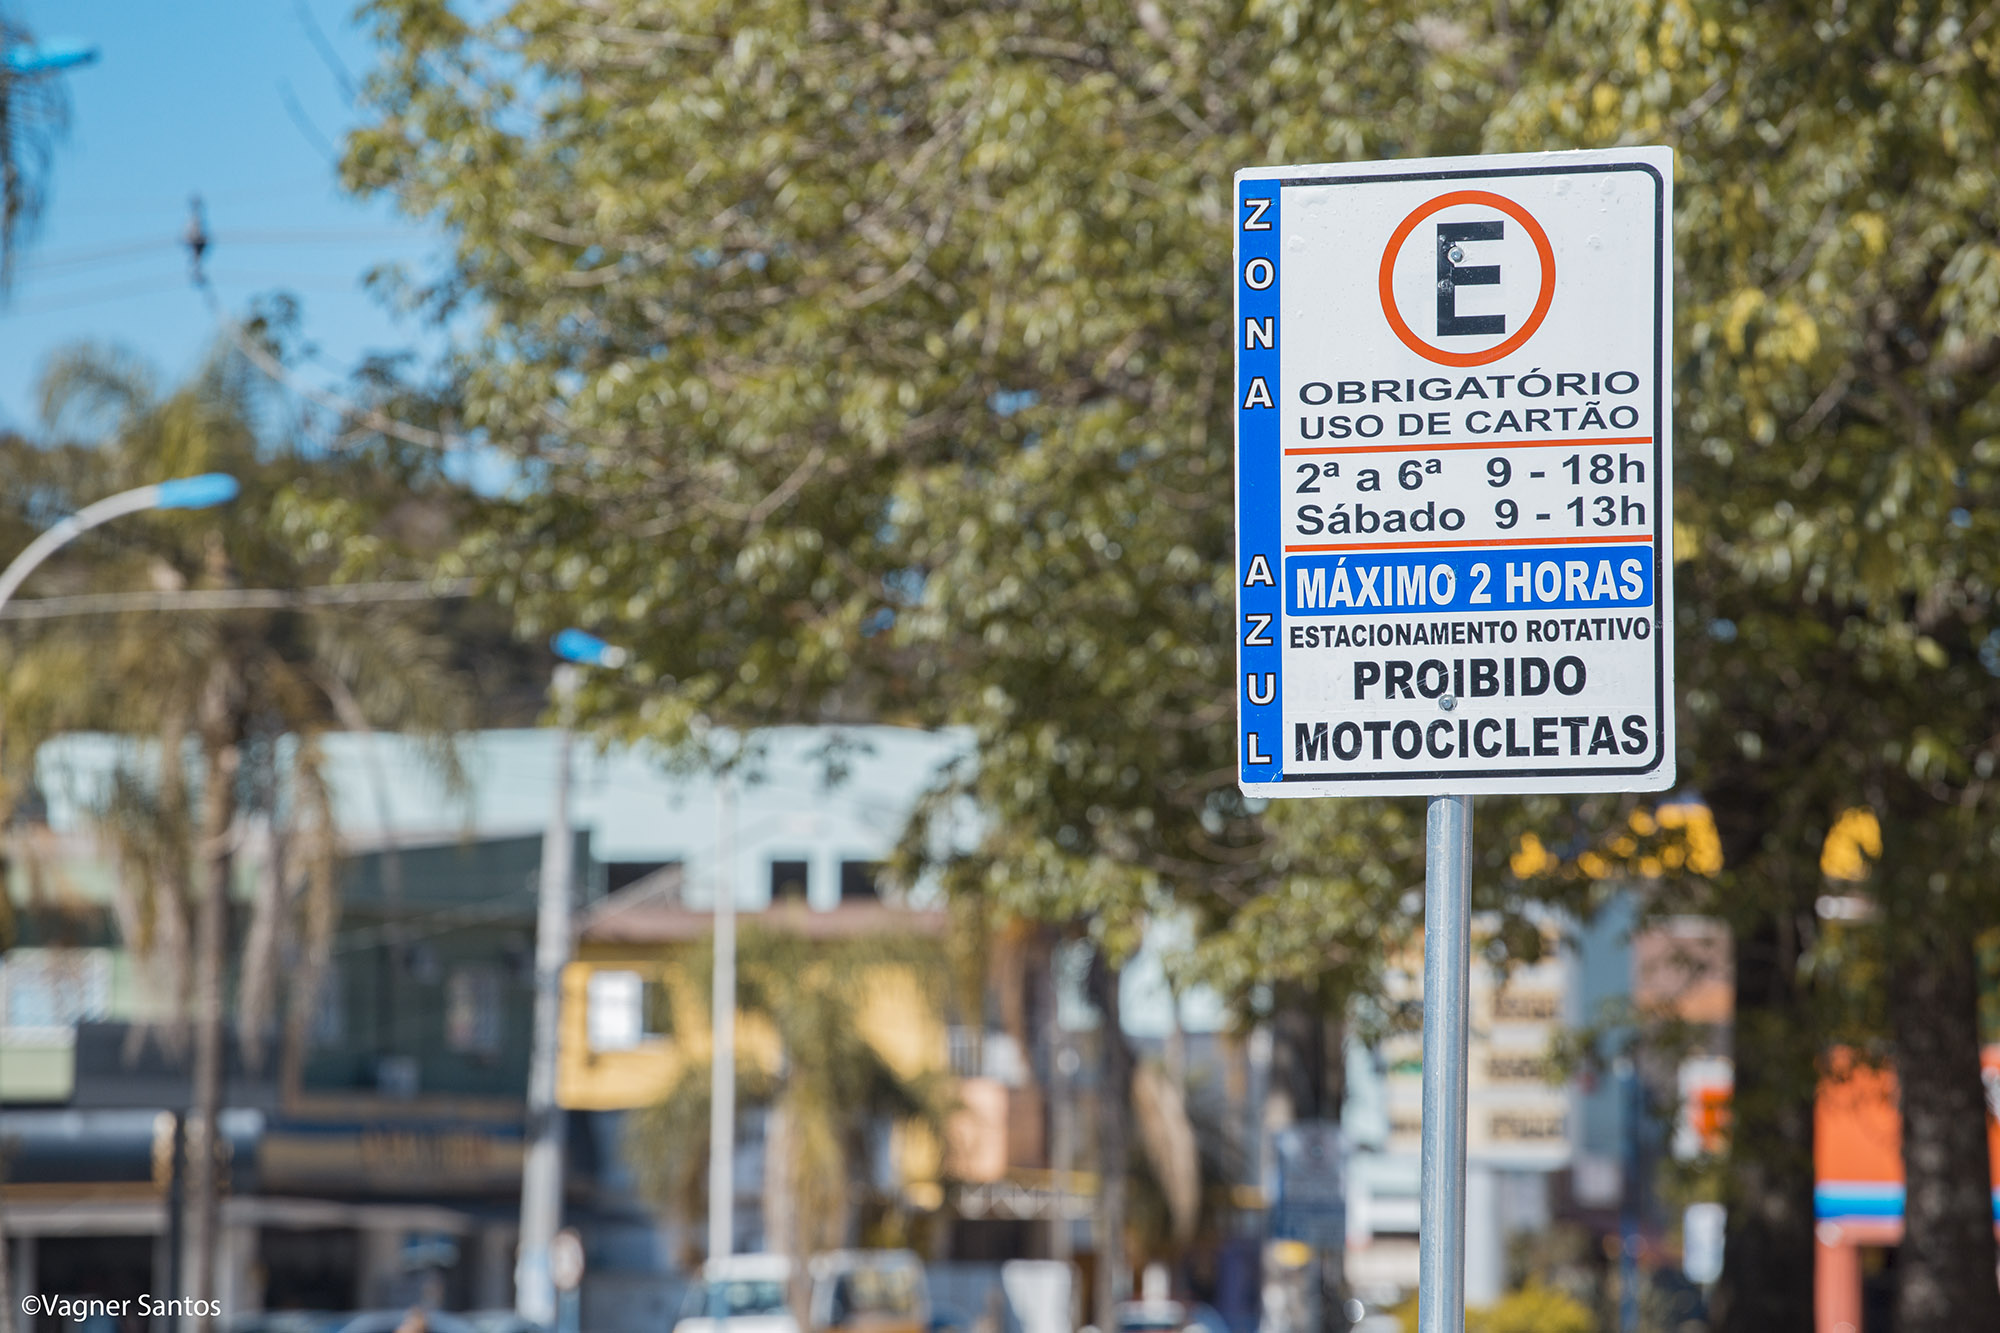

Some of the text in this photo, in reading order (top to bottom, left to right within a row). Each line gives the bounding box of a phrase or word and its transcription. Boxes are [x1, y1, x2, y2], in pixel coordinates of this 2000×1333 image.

[1437, 220, 1506, 336] E
[1243, 198, 1275, 410] ZONA
[1299, 368, 1640, 406] OBRIGATÓRIO
[1300, 401, 1639, 440] USO DE CARTÃO
[1356, 467, 1381, 491] a
[1486, 456, 1512, 488] 9
[1562, 452, 1645, 486] 18h
[1296, 501, 1465, 535] Sábado
[1494, 498, 1519, 530] 9
[1567, 494, 1645, 527] 13h
[1296, 557, 1644, 609] MÁXIMO 2 HORAS
[1290, 616, 1651, 649] ESTACIONAMENTO ROTATIVO
[1243, 554, 1276, 765] AZUL
[1353, 655, 1587, 700] PROIBIDO
[1294, 714, 1649, 762] MOTOCICLETAS
